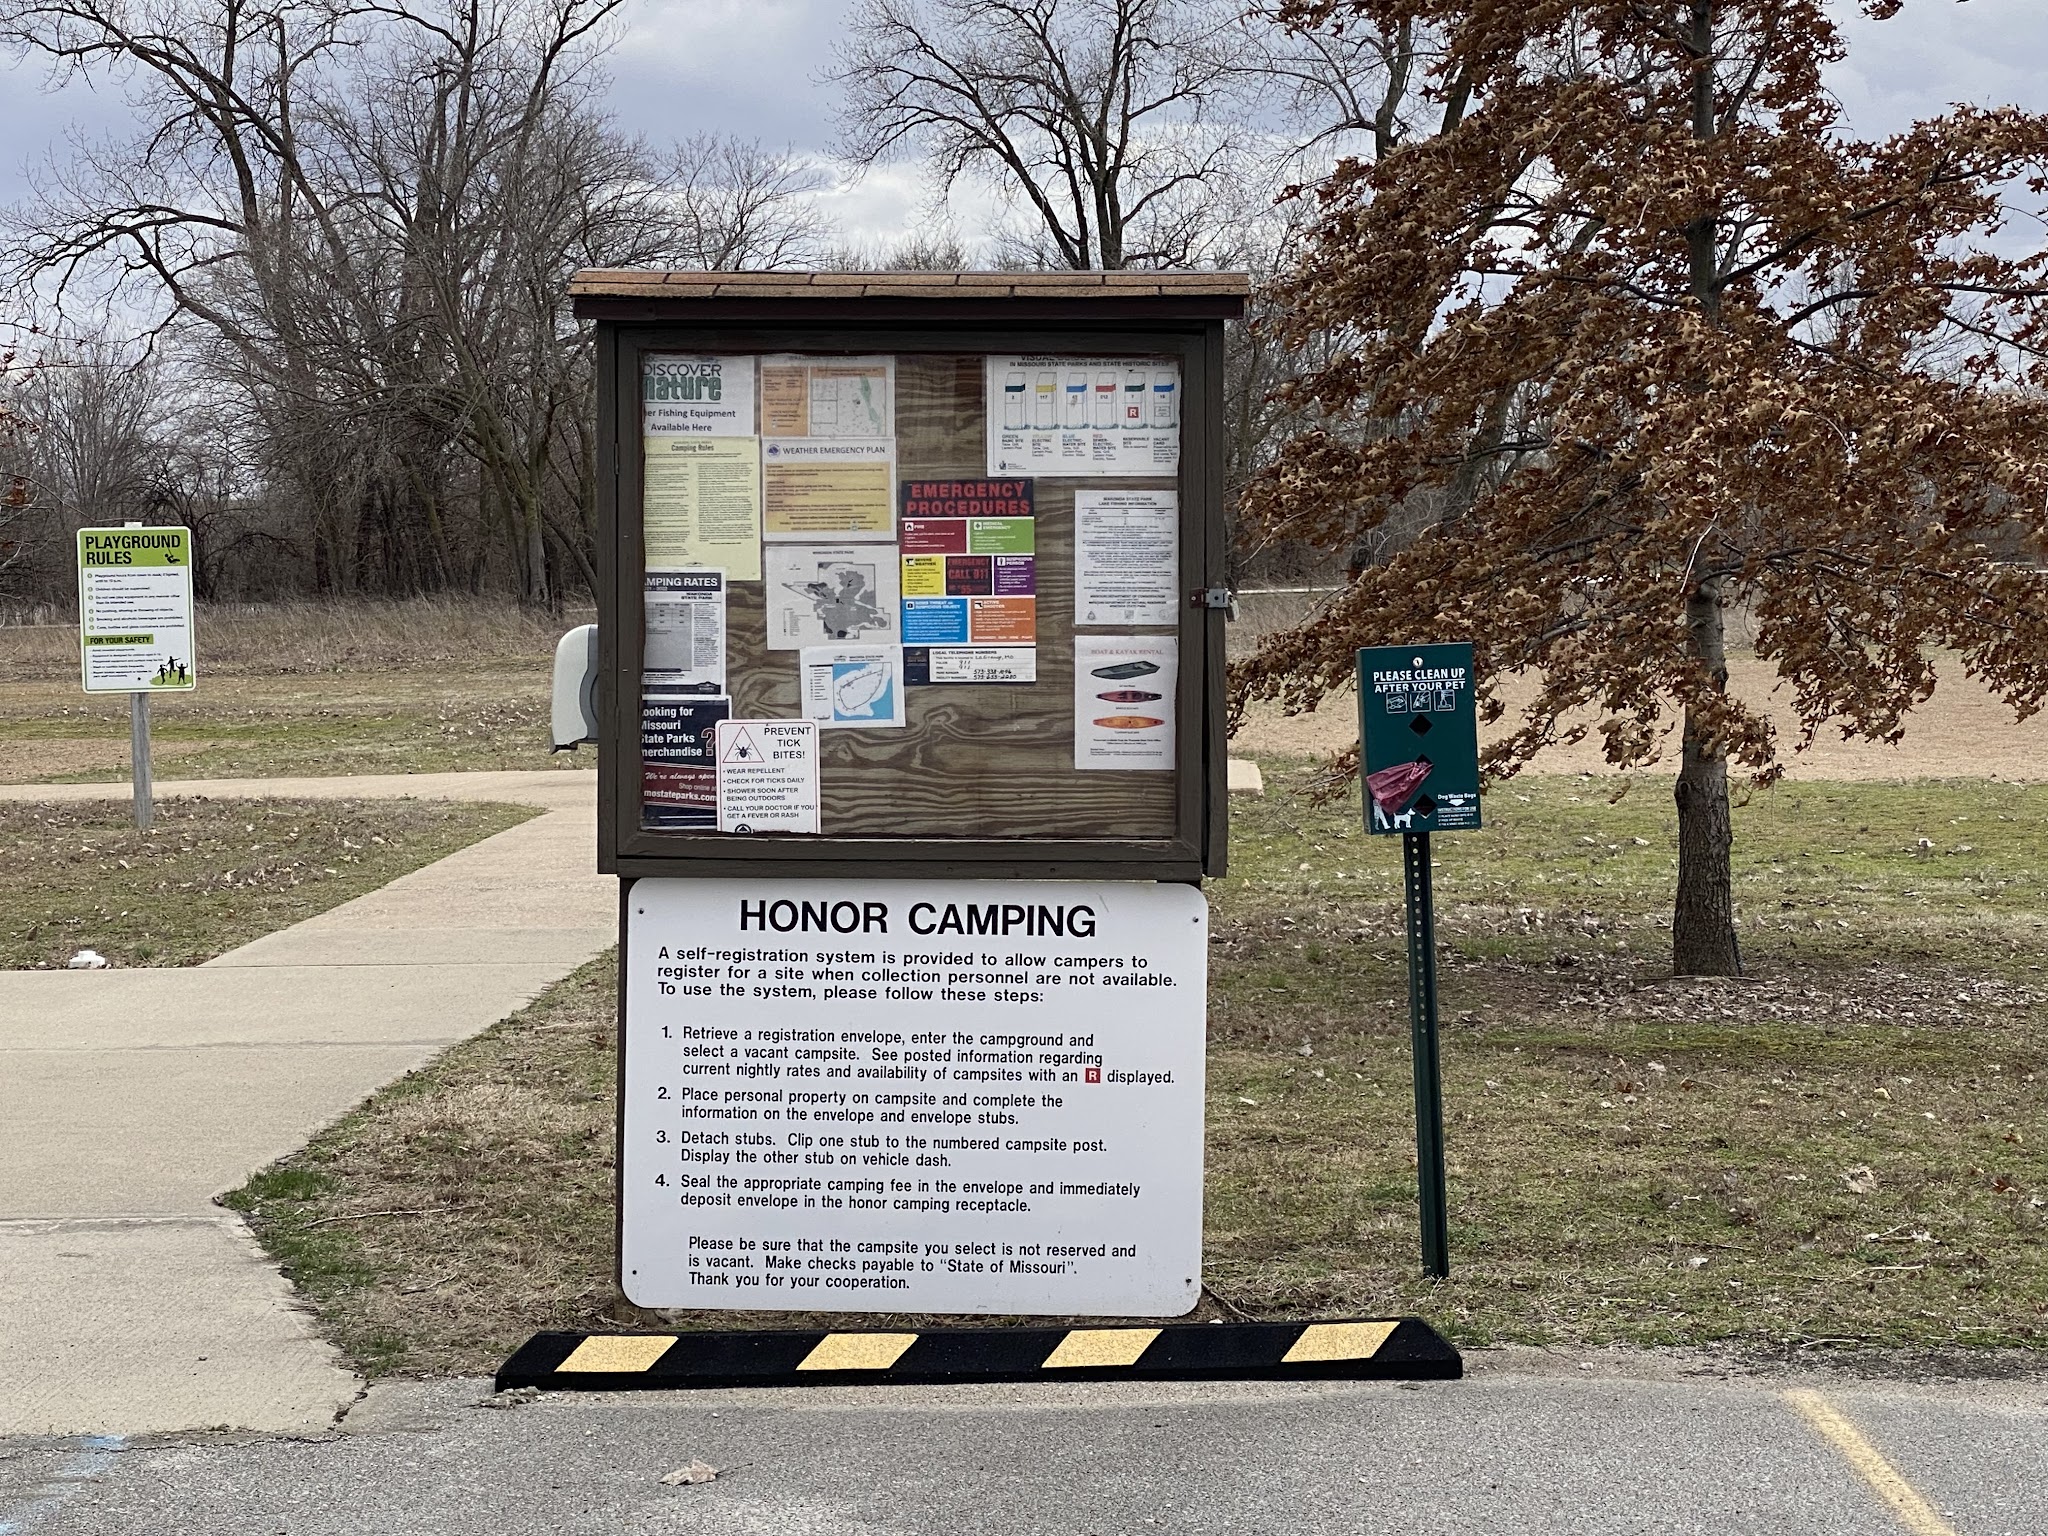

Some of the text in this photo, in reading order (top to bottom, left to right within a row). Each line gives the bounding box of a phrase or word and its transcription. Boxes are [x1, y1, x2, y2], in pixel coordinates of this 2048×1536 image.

[643, 364, 721, 376] DISCOVER
[643, 376, 721, 400] nature
[658, 410, 688, 418] Fishing
[690, 410, 736, 418] Equipment
[1129, 408, 1137, 416] R
[672, 444, 697, 452] Camping
[912, 482, 1024, 498] EMERGENCY
[907, 500, 1030, 515] PROCEDURES
[86, 535, 180, 549] PLAYGROUND
[86, 551, 132, 565] RULES
[949, 569, 988, 579] CALL 911
[644, 578, 718, 586] MPING RATES
[125, 636, 150, 644] SAFETY
[1373, 668, 1465, 681] PLEASE CLEAN UP
[1374, 681, 1466, 693] AFTER YOUR PET
[642, 706, 694, 718] ooking for
[764, 727, 811, 736] PREVENT
[667, 734, 695, 743] Parks
[777, 739, 800, 747] TICK
[642, 746, 702, 757] merchandise
[773, 751, 805, 759] BITES!
[645, 772, 667, 780] We're
[669, 772, 695, 781] always
[678, 782, 692, 790] Shop
[644, 790, 716, 801] mostateparks.com
[741, 899, 1095, 938] HONOR CAMPING
[658, 946, 1147, 970] A self-registration system is provided to allow campers to
[658, 964, 1176, 986] register for a site when collection personnel are not available.
[658, 982, 1043, 1004] To use the system, please follow these steps:
[662, 1026, 1094, 1048] 1. Retrieve a registration envelope, enter the campground and
[683, 1044, 1102, 1067] select a vacant campsite. See posted information regarding
[683, 1063, 1174, 1086] current nightly rates and availability of campsites with an R displayed.
